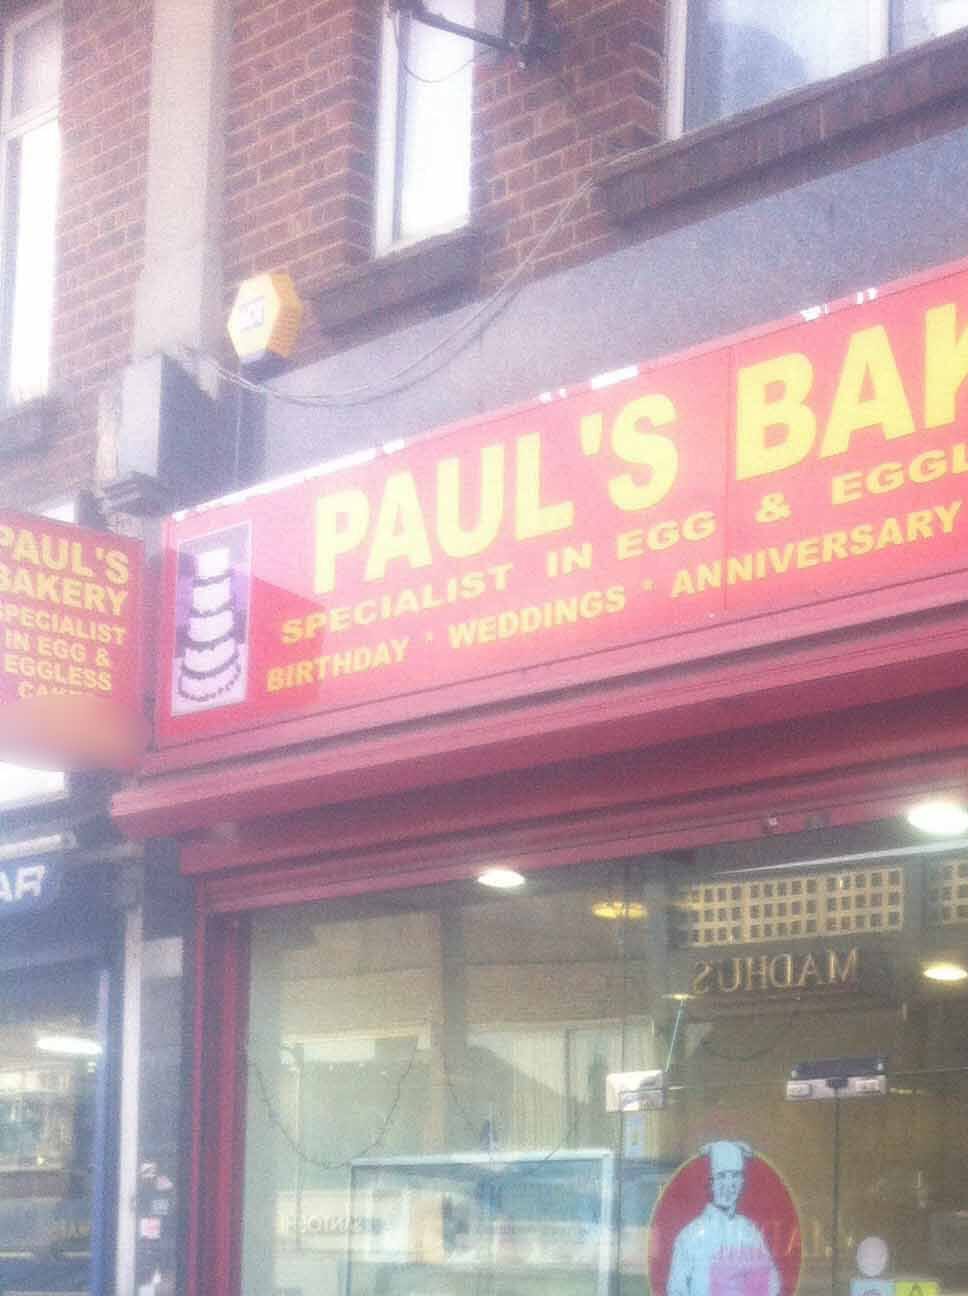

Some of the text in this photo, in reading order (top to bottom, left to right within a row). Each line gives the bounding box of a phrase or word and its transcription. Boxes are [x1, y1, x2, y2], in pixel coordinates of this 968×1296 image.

[280, 565, 513, 645] SPECIALIST
[546, 543, 593, 577] IN
[617, 510, 717, 560] EGG
[754, 492, 791, 526] &
[313, 393, 679, 595] PAUL'S
[4, 628, 111, 668] IN EGG &
[4, 653, 113, 692] EGGLESS
[266, 638, 410, 693] BIRTHDAY
[448, 585, 627, 650] WEDDINGS
[671, 501, 963, 599] ANNIVERSARY
